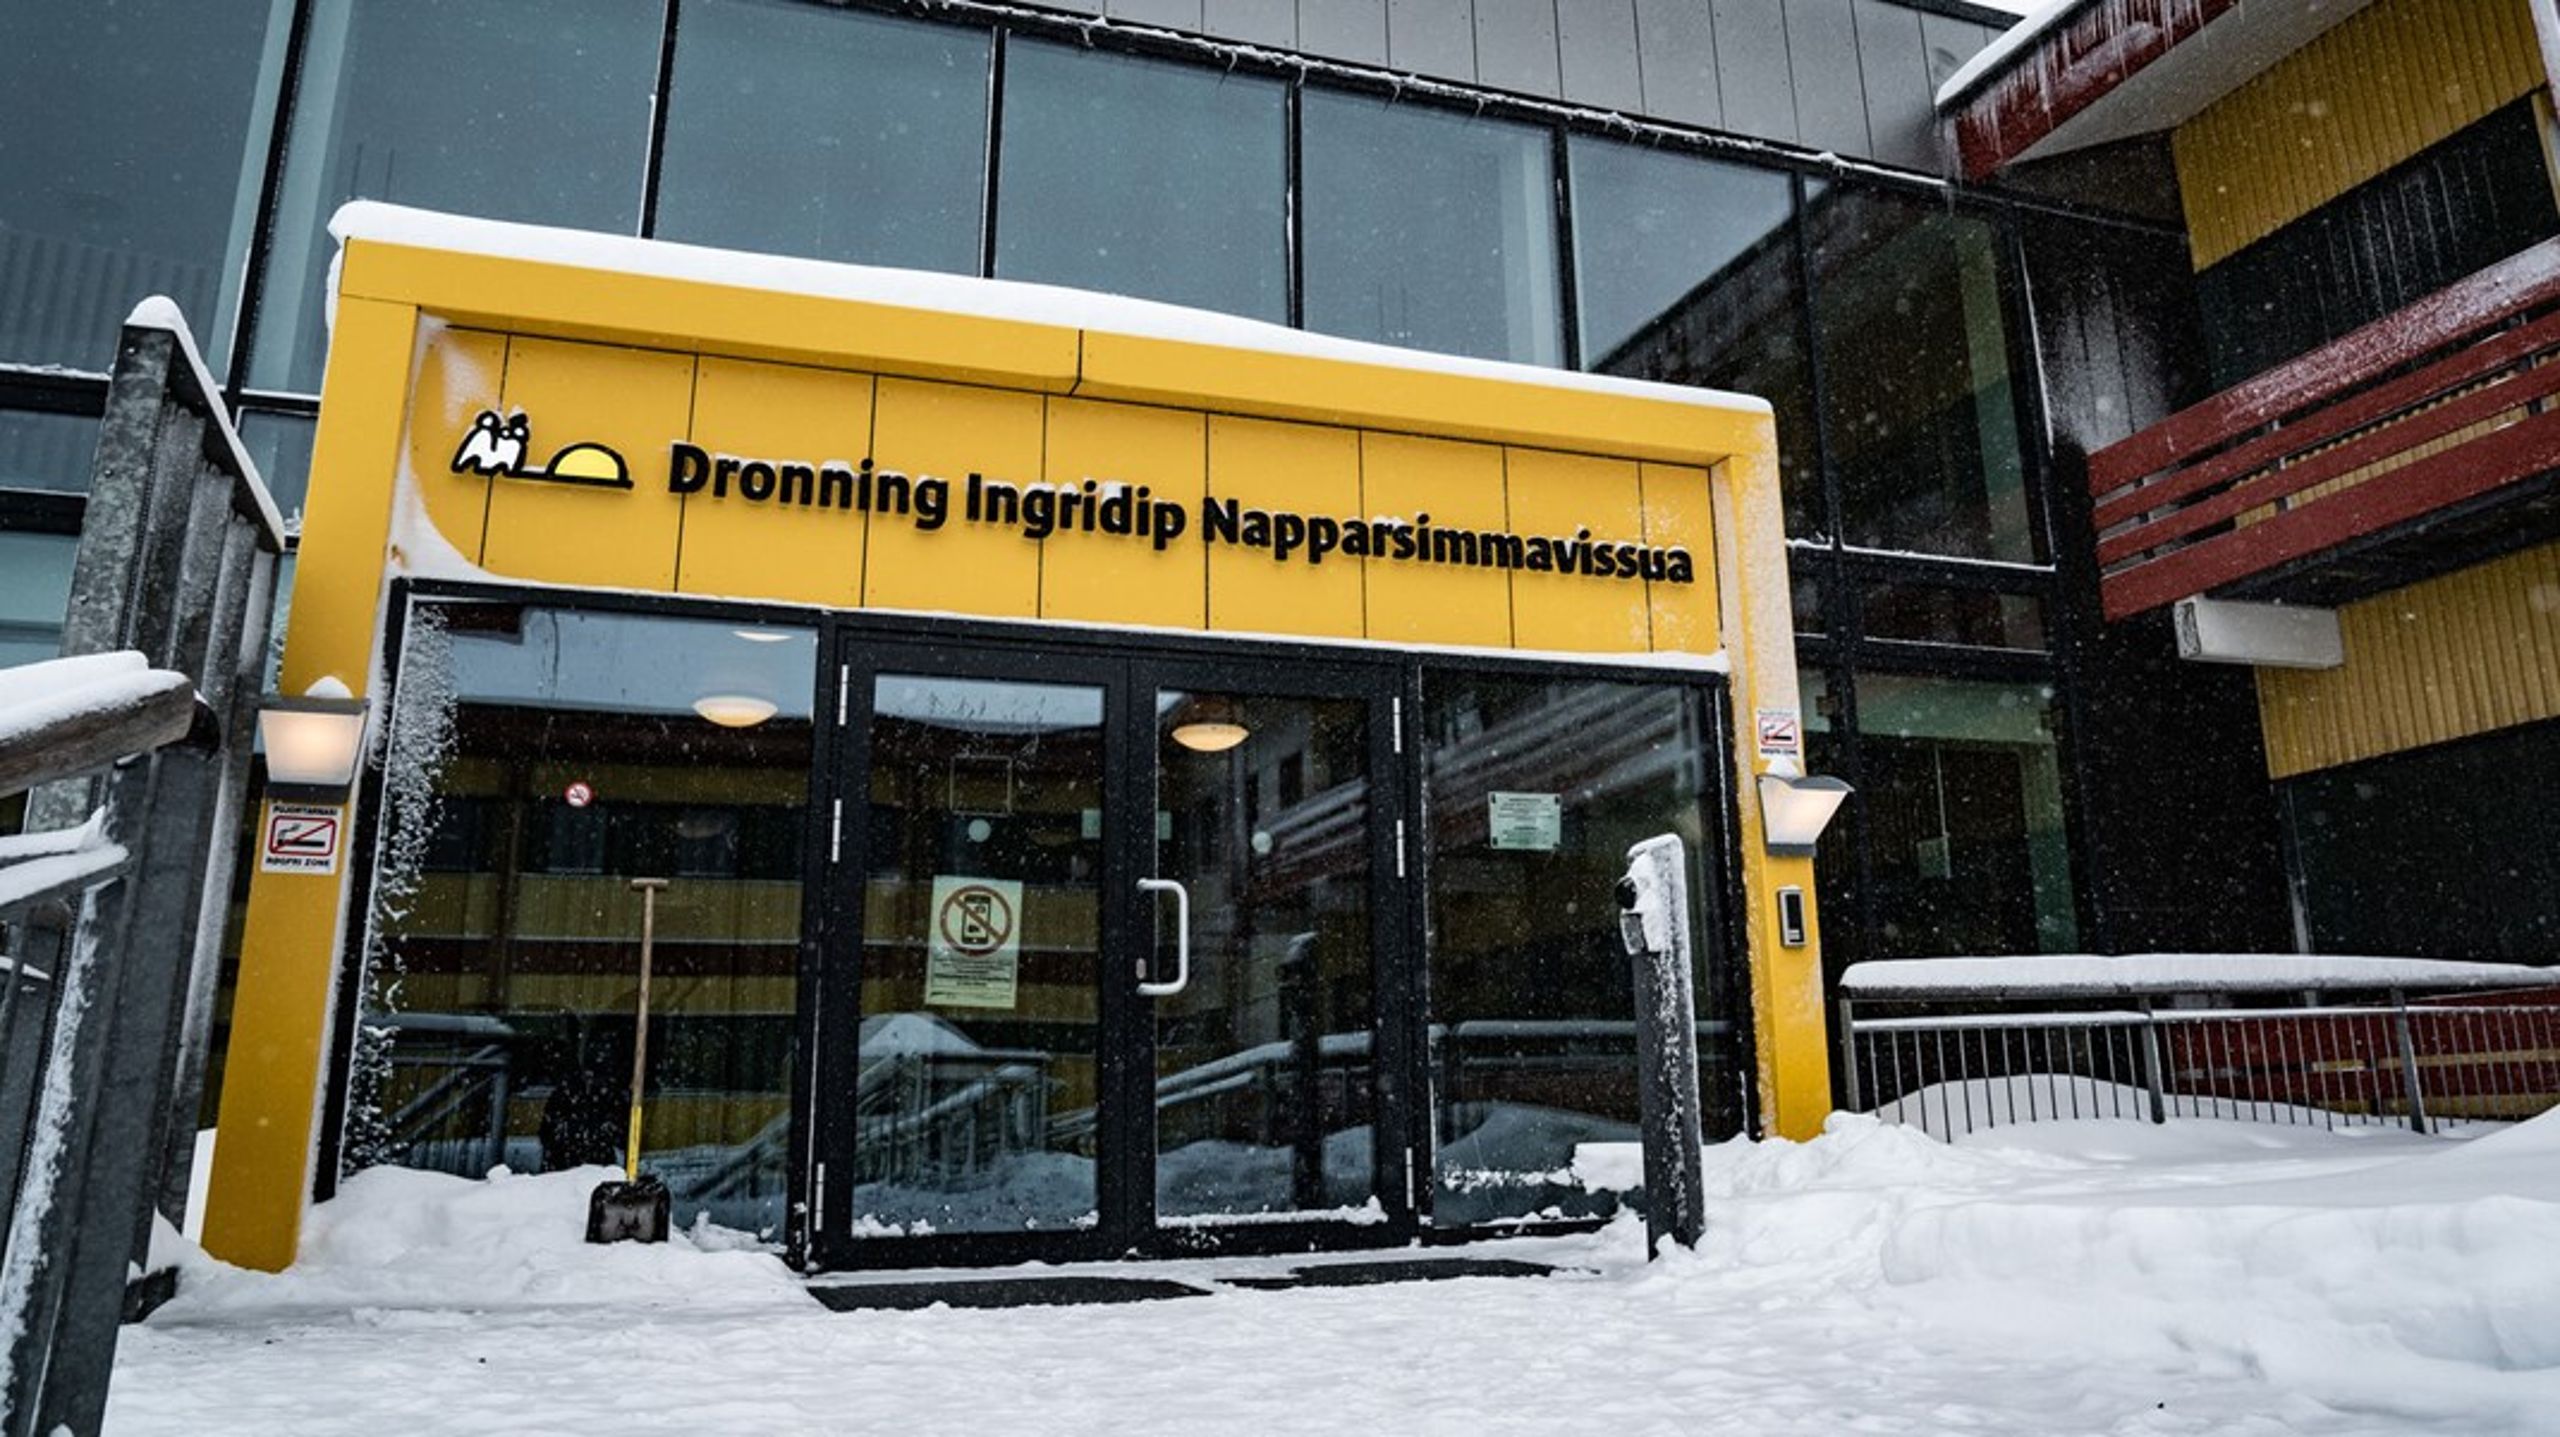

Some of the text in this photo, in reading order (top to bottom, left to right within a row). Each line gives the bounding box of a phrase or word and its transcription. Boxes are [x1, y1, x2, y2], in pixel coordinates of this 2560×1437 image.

[669, 443, 1695, 589] Dronning Ingridip Napparsimmavissua
